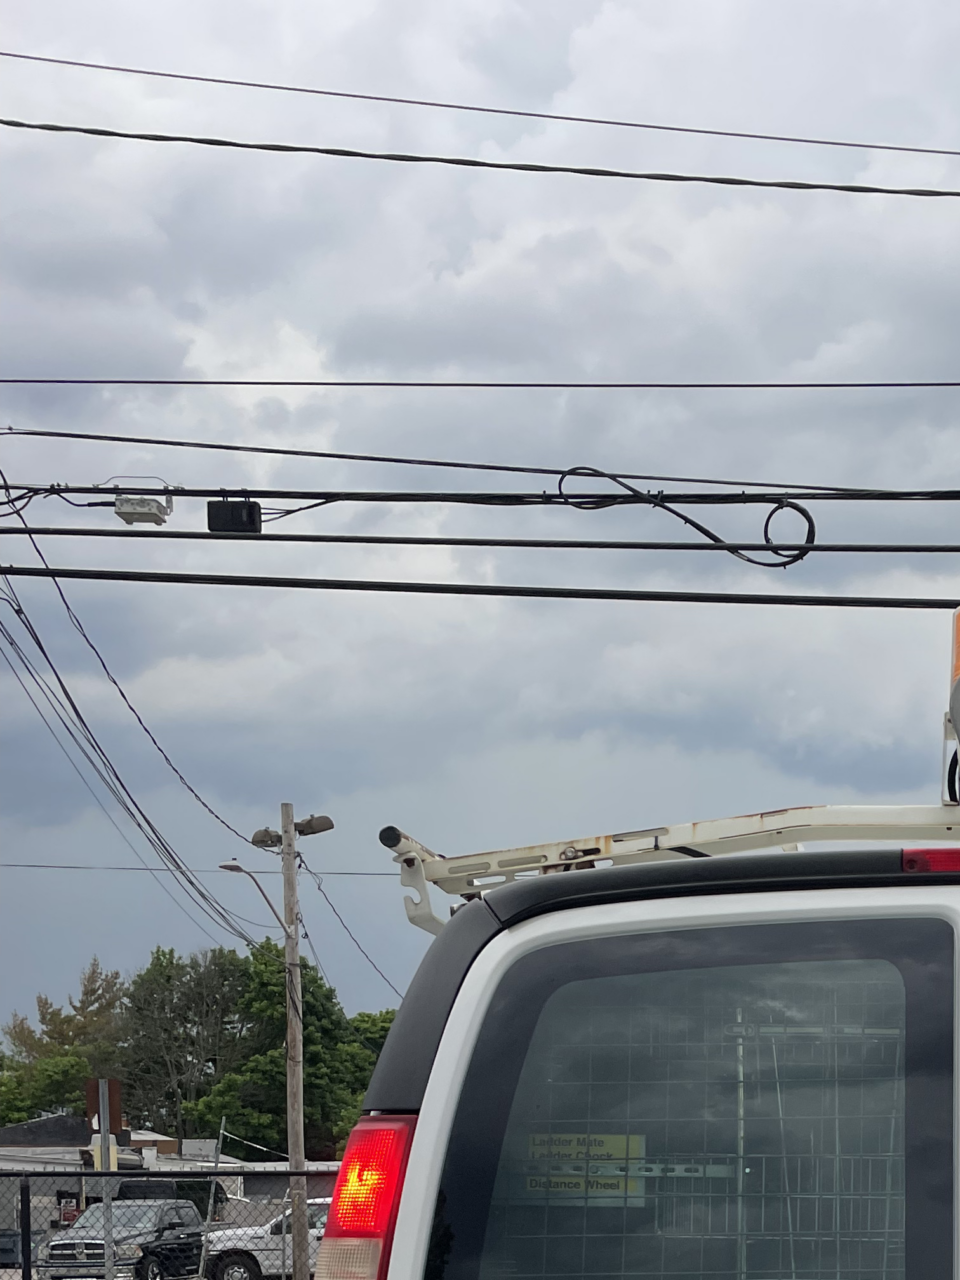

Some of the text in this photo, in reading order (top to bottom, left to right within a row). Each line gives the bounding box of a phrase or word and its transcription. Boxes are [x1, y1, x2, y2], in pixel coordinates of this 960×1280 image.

[532, 1136, 605, 1148] Ladder Mate
[529, 1178, 620, 1190] Distance Wheel
